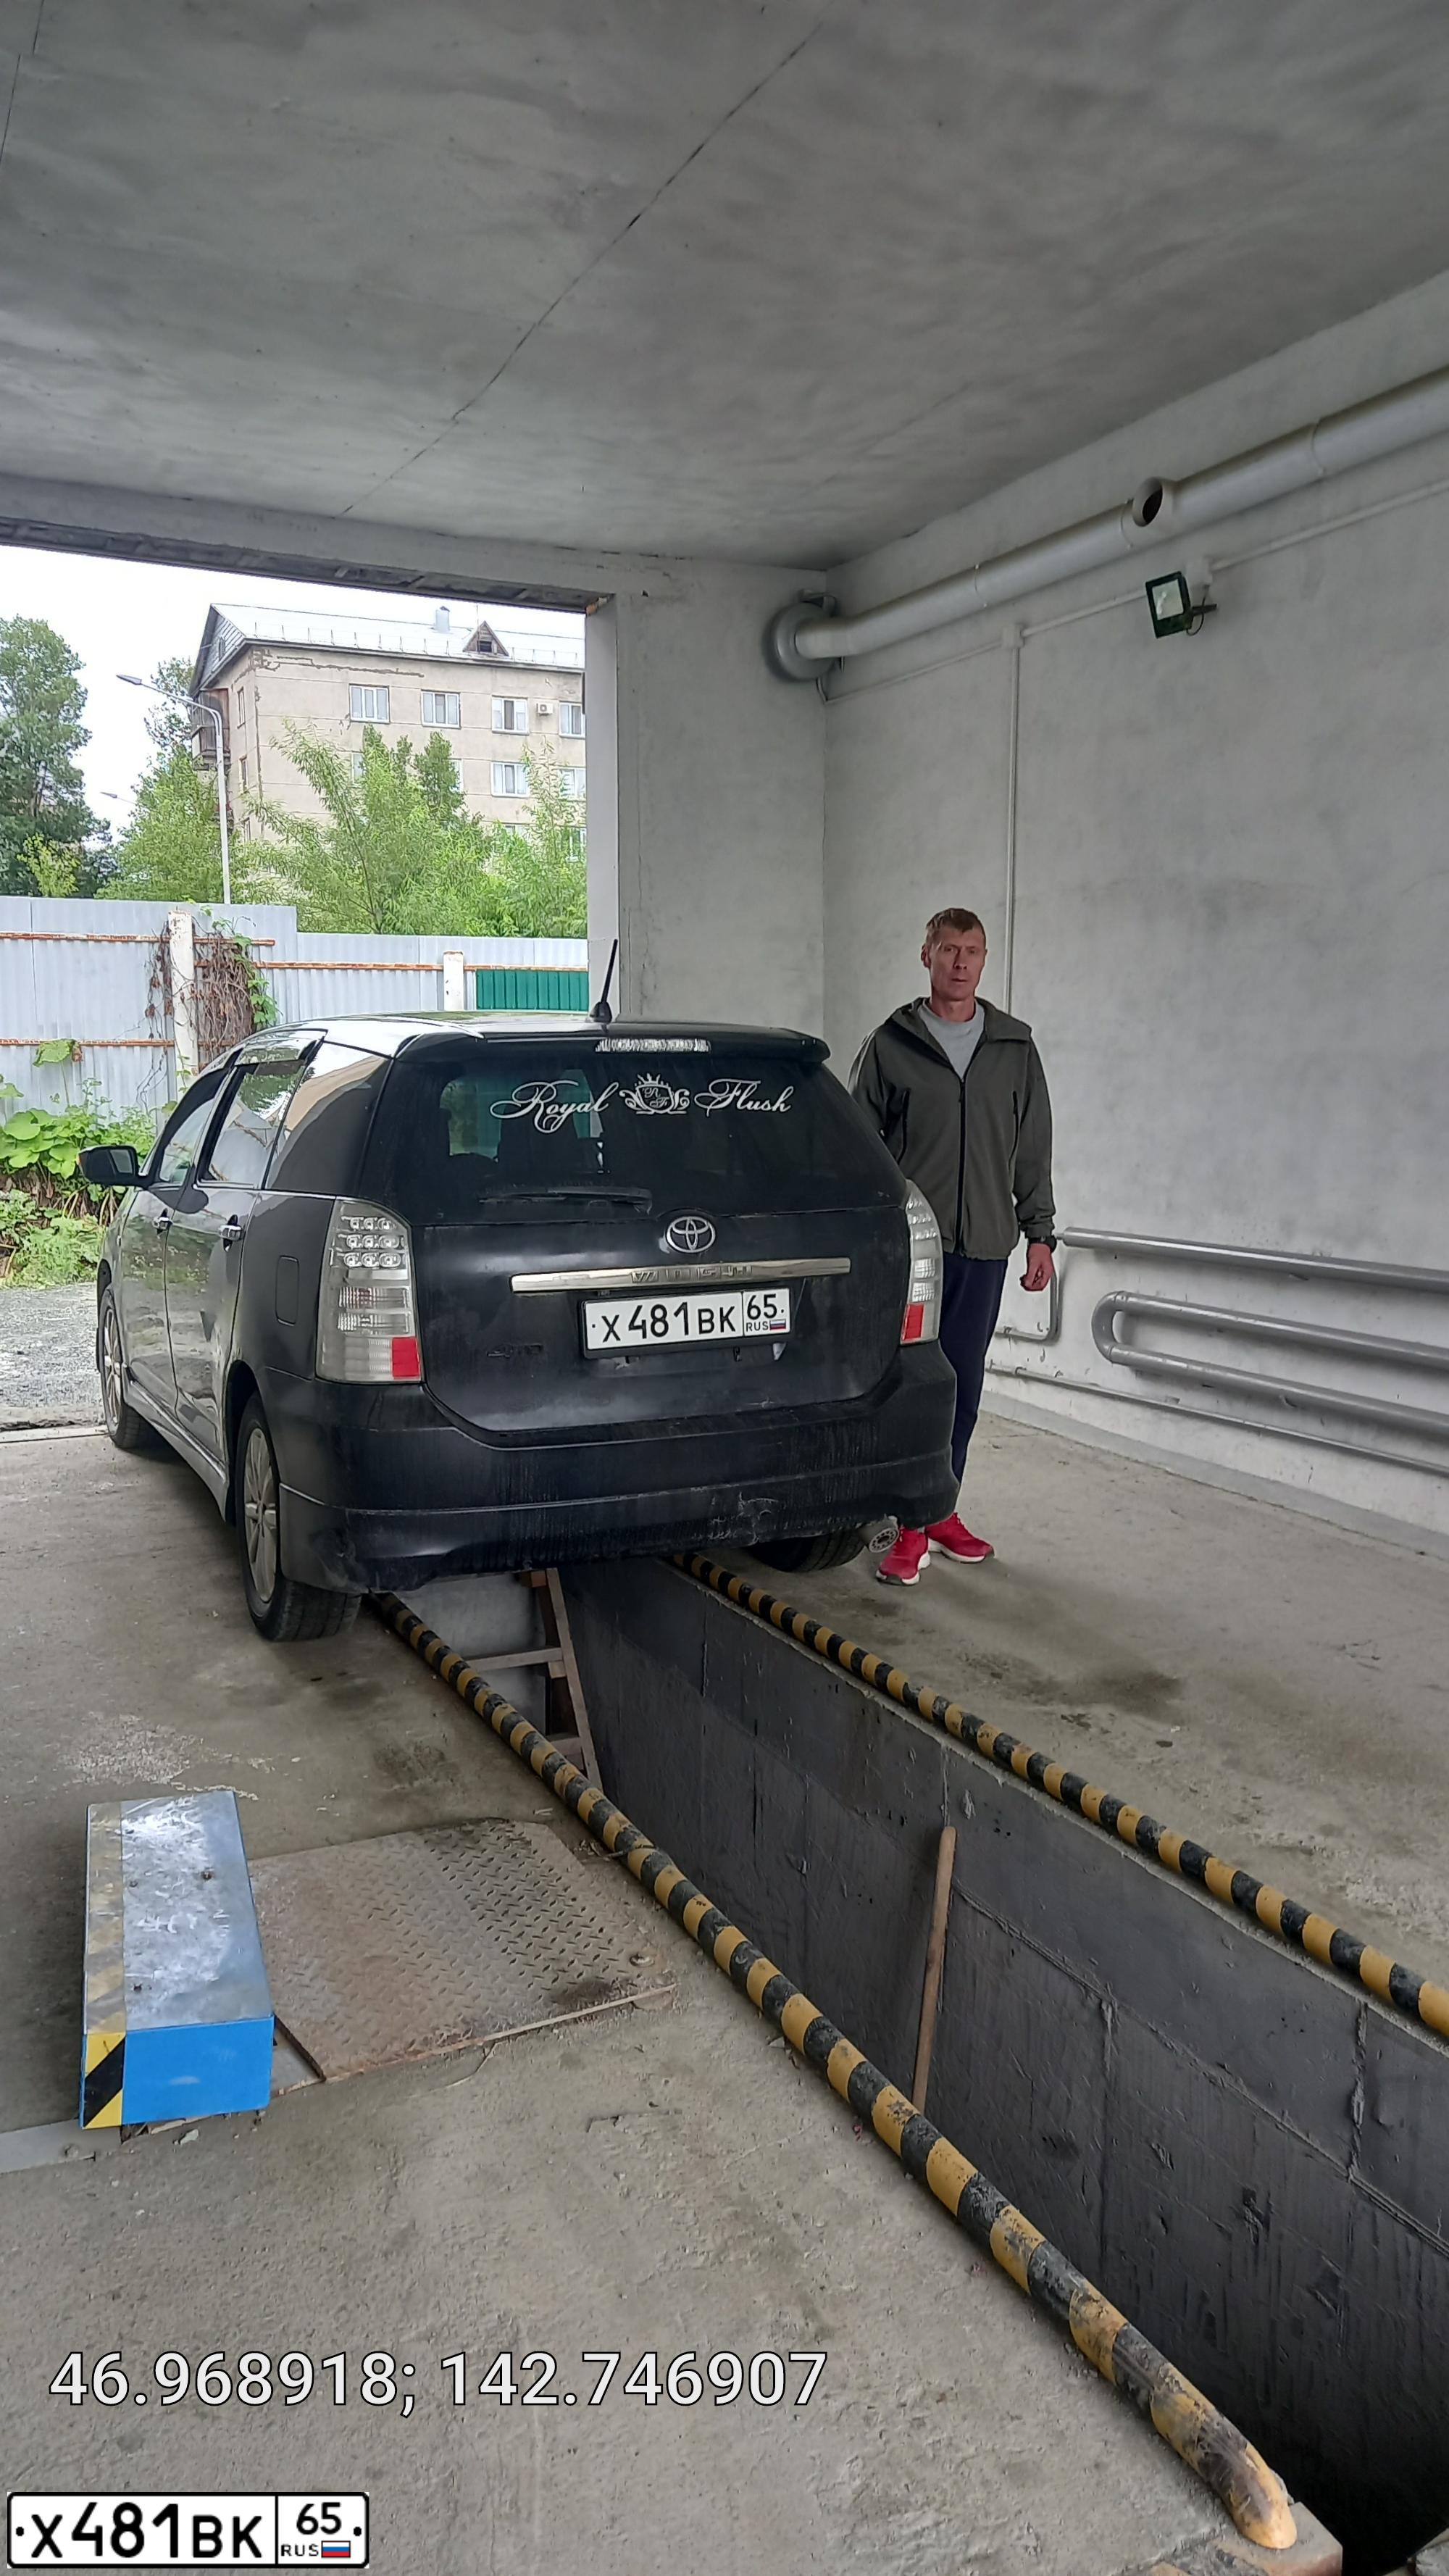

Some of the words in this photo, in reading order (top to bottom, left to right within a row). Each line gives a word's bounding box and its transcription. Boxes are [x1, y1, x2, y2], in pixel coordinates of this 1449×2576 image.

[490, 1080, 619, 1133] Royal
[694, 1078, 793, 1117] Flush
[746, 1293, 777, 1320] 65
[746, 1321, 769, 1332] RUS
